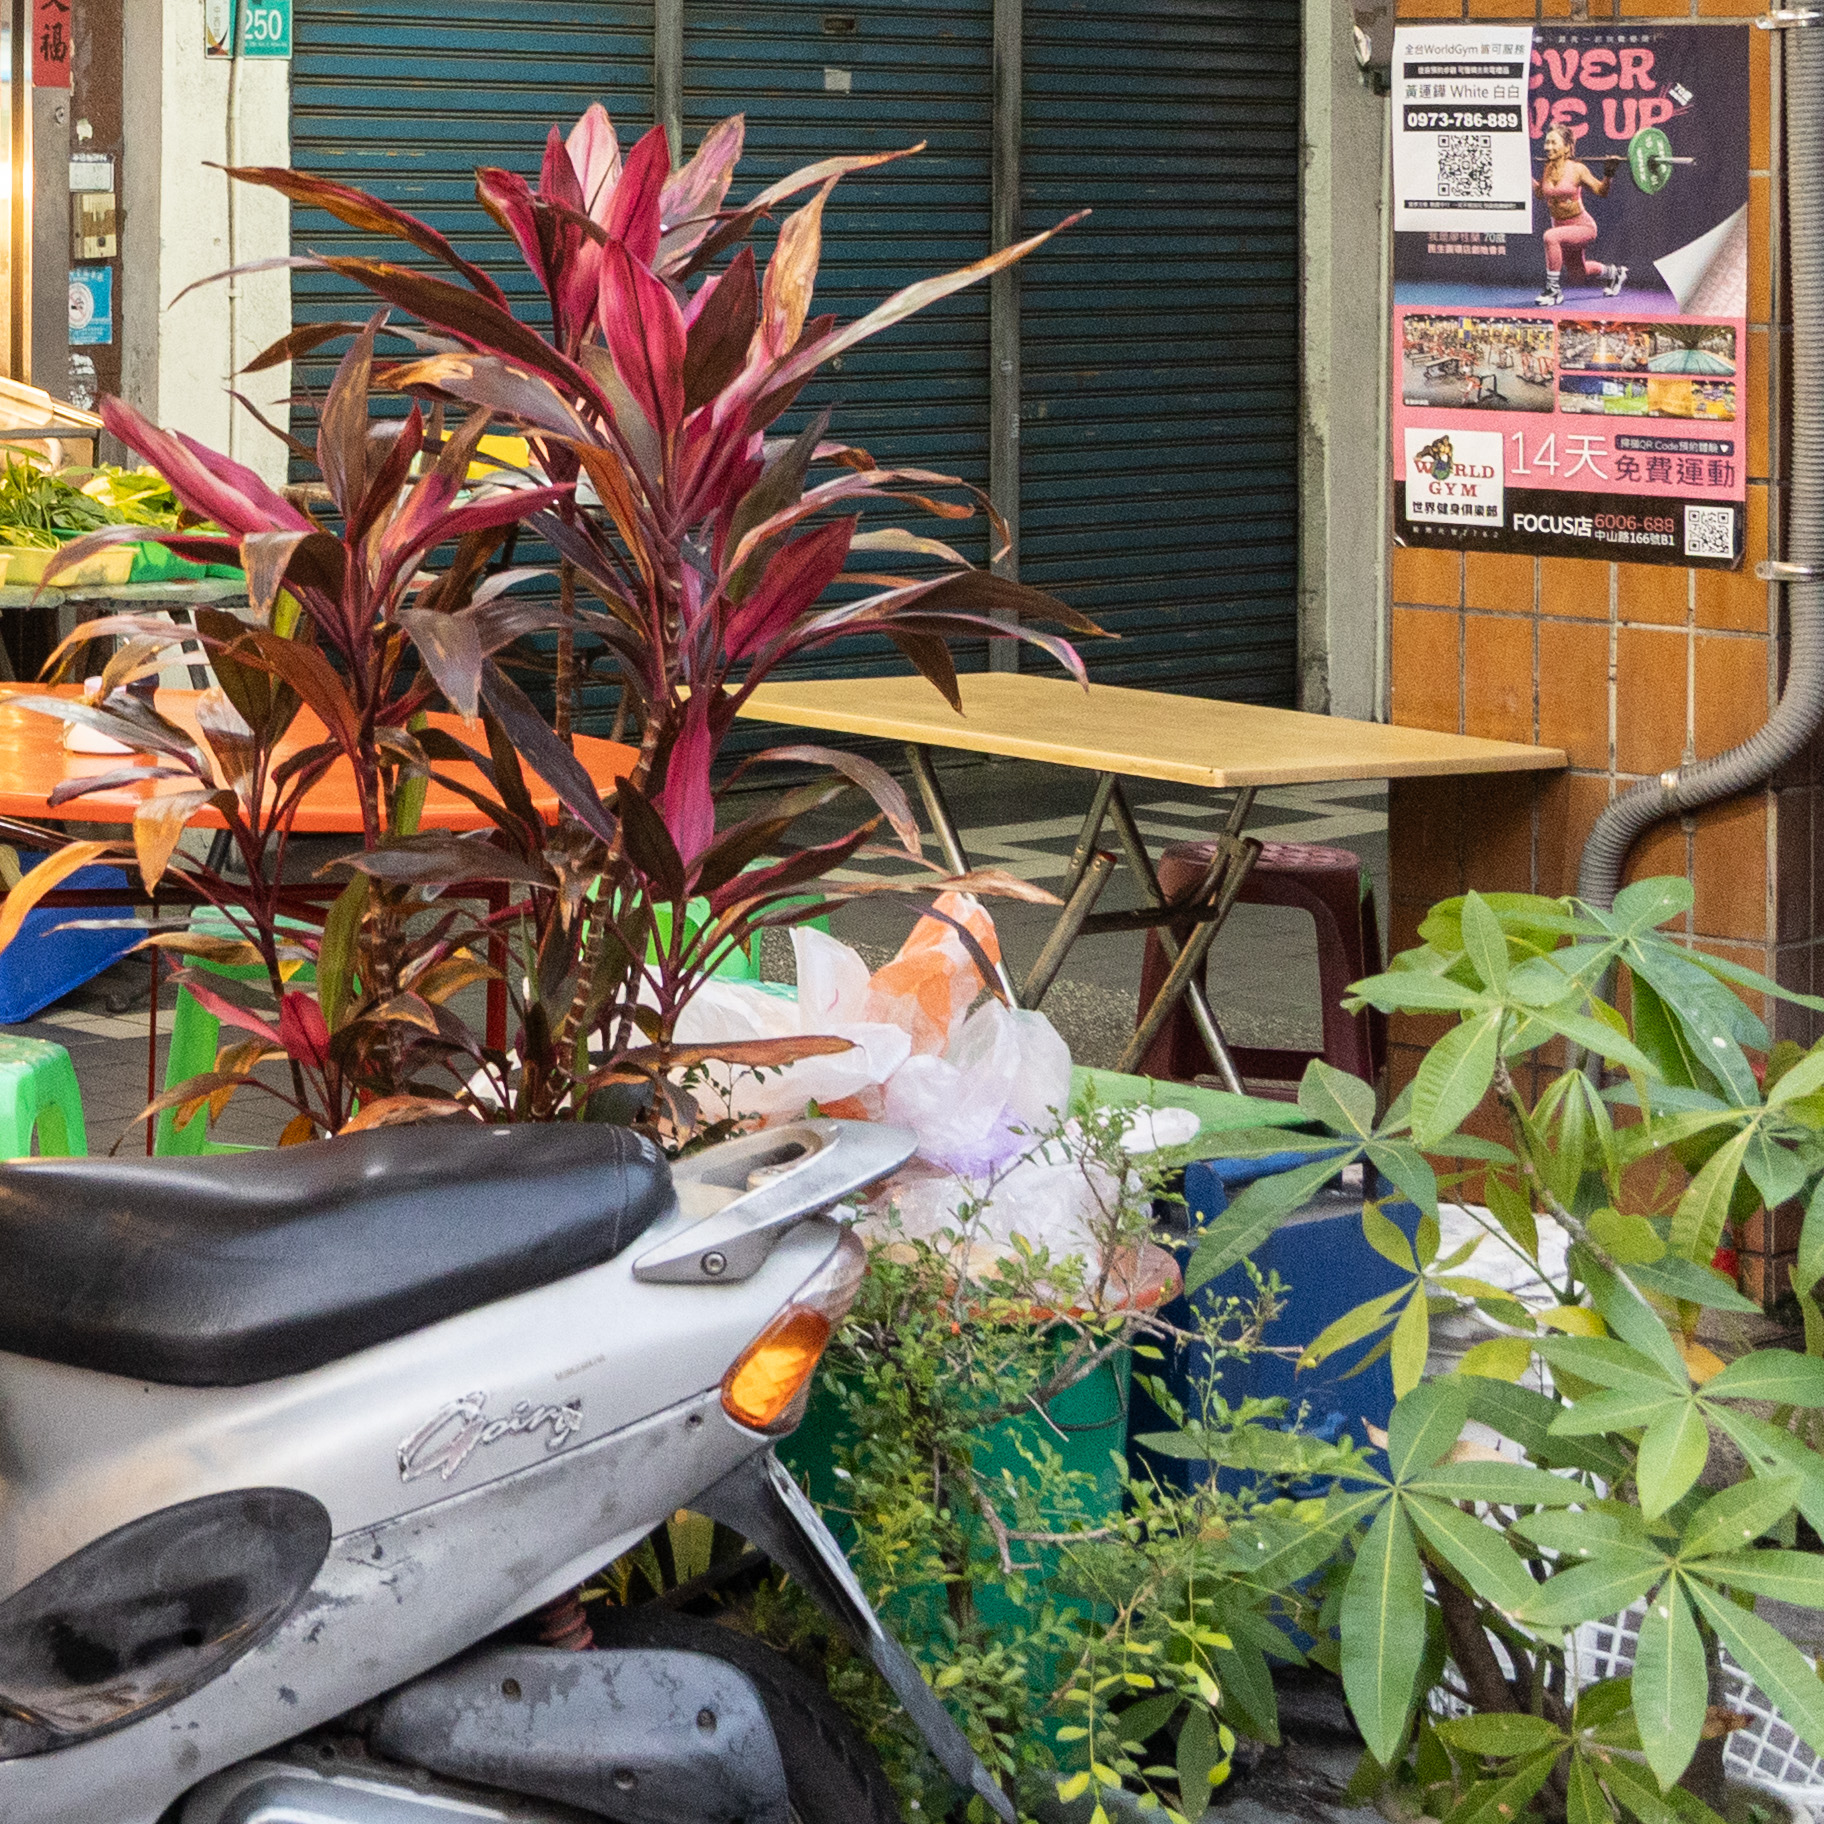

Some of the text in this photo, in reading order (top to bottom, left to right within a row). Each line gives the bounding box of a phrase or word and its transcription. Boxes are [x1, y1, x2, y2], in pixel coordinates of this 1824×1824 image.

[1450, 85, 1489, 99] White
[1493, 85, 1520, 99] 白白
[1407, 112, 1519, 128] 0973-786-889
[1602, 97, 1674, 140] UP
[1510, 430, 1609, 480] 14天
[1614, 454, 1736, 489] 免費運動
[1428, 481, 1478, 498] GYM
[1512, 512, 1594, 538] FOCUS店
[1594, 513, 1675, 533] 6006-688
[1594, 530, 1676, 547] 中山路166號B1
